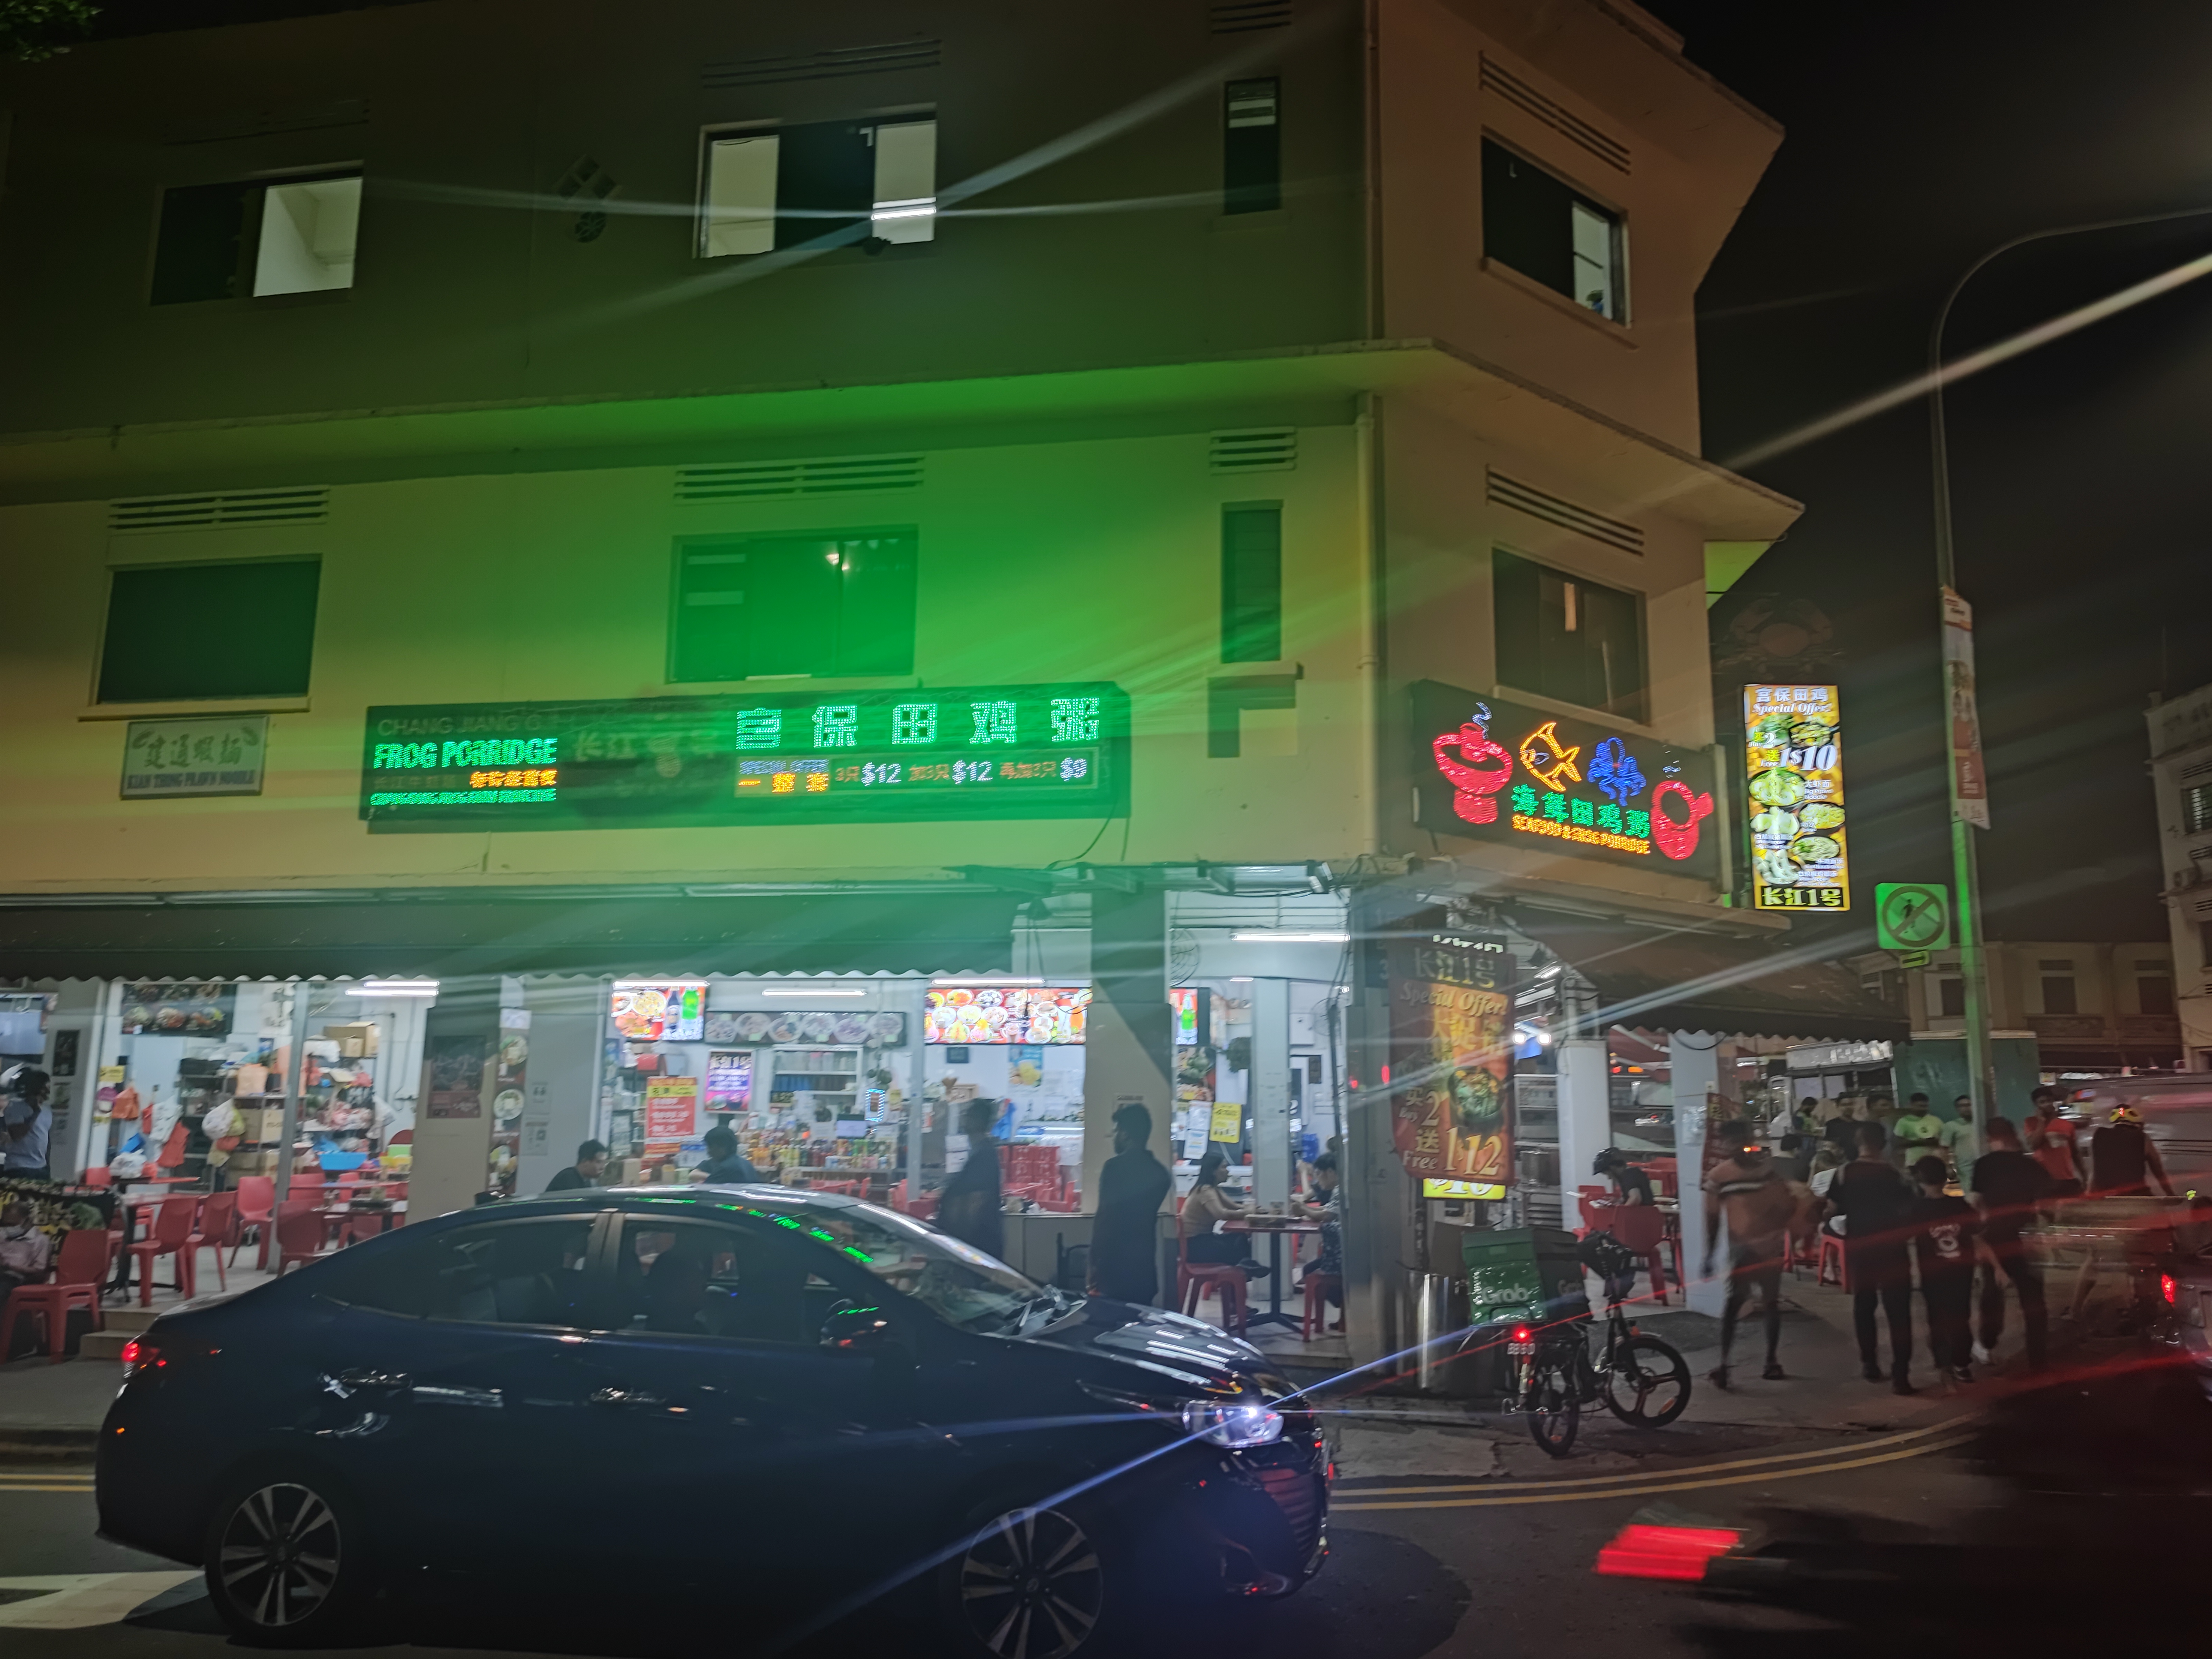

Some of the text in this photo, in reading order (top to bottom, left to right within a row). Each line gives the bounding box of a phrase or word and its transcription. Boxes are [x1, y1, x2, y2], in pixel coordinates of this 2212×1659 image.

[1755, 687, 1829, 703] 宫保田鸡
[1752, 702, 1833, 716] Special Offer!
[736, 698, 1099, 749] 宫保田鸡粥
[374, 738, 558, 769] FROG PORRIDGE
[860, 762, 902, 787] $12
[952, 760, 993, 784] $12
[1762, 887, 1841, 906] 长江1号
[1399, 981, 1509, 1017] Special Offer!
[1421, 1091, 1440, 1127] 2
[1402, 1150, 1438, 1169] Free
[1481, 1283, 1530, 1305] Grab
